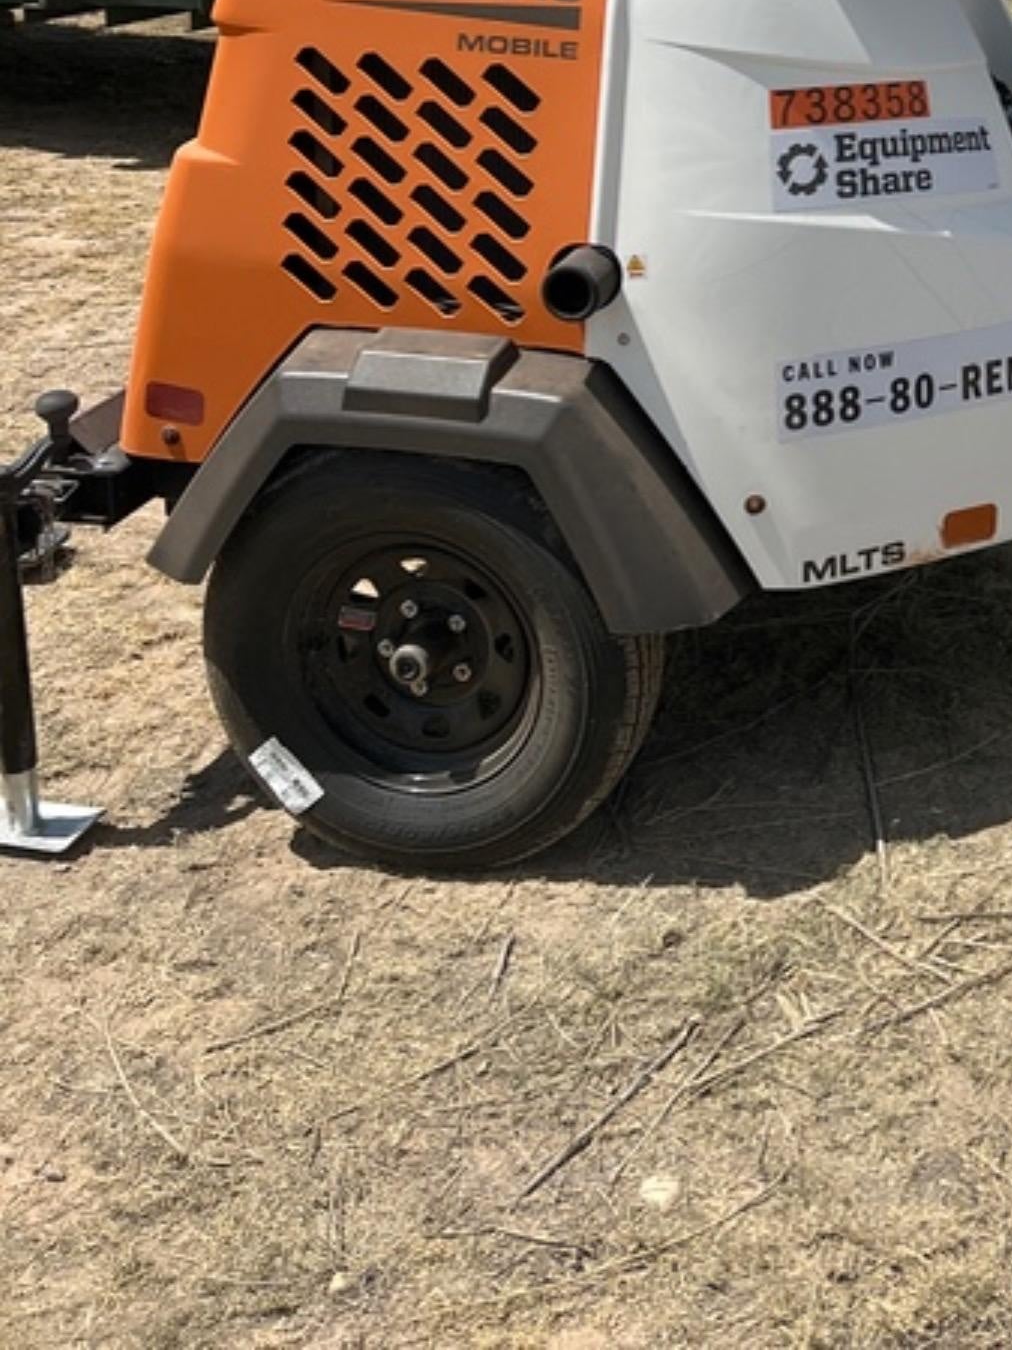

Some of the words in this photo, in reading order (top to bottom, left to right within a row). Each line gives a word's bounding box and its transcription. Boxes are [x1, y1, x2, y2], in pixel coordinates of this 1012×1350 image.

[457, 32, 580, 61] MOBILE
[772, 82, 928, 126] 738358
[833, 125, 992, 166] Equipment
[835, 167, 933, 199] Share
[781, 359, 839, 382] CALL
[847, 350, 895, 373] NOW
[802, 541, 907, 583] MLTS
